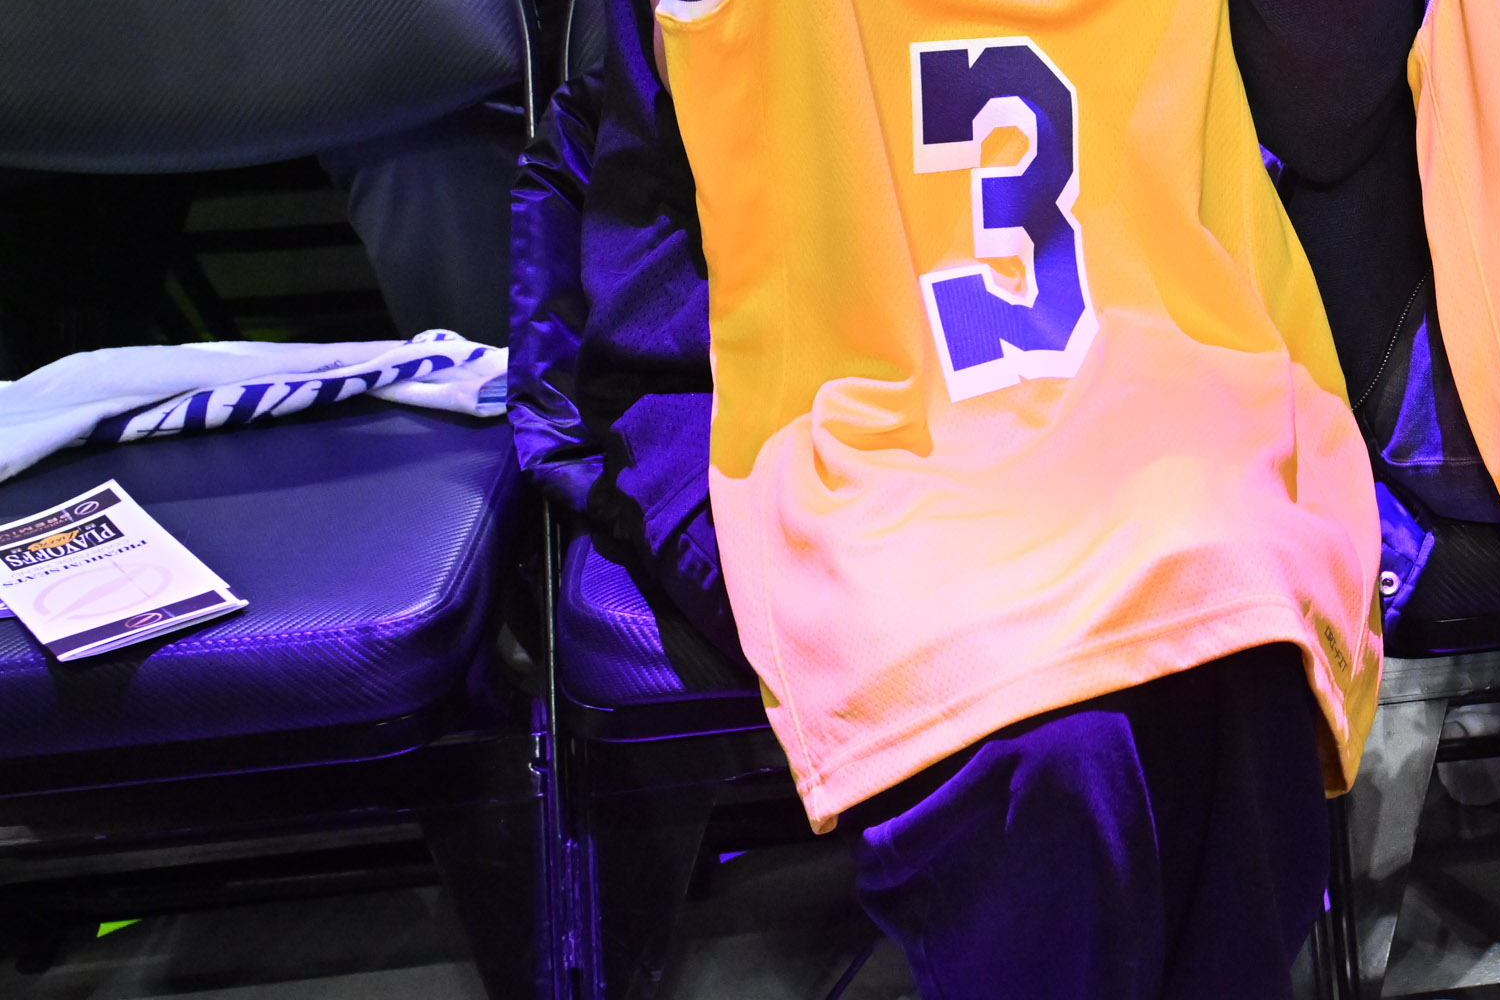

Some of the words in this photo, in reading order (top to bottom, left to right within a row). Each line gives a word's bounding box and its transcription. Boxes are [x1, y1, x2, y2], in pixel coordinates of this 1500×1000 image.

[909, 36, 1099, 403] 3
[5, 522, 117, 568] PLAYOFFS
[1324, 625, 1347, 672] DRI-FIT
